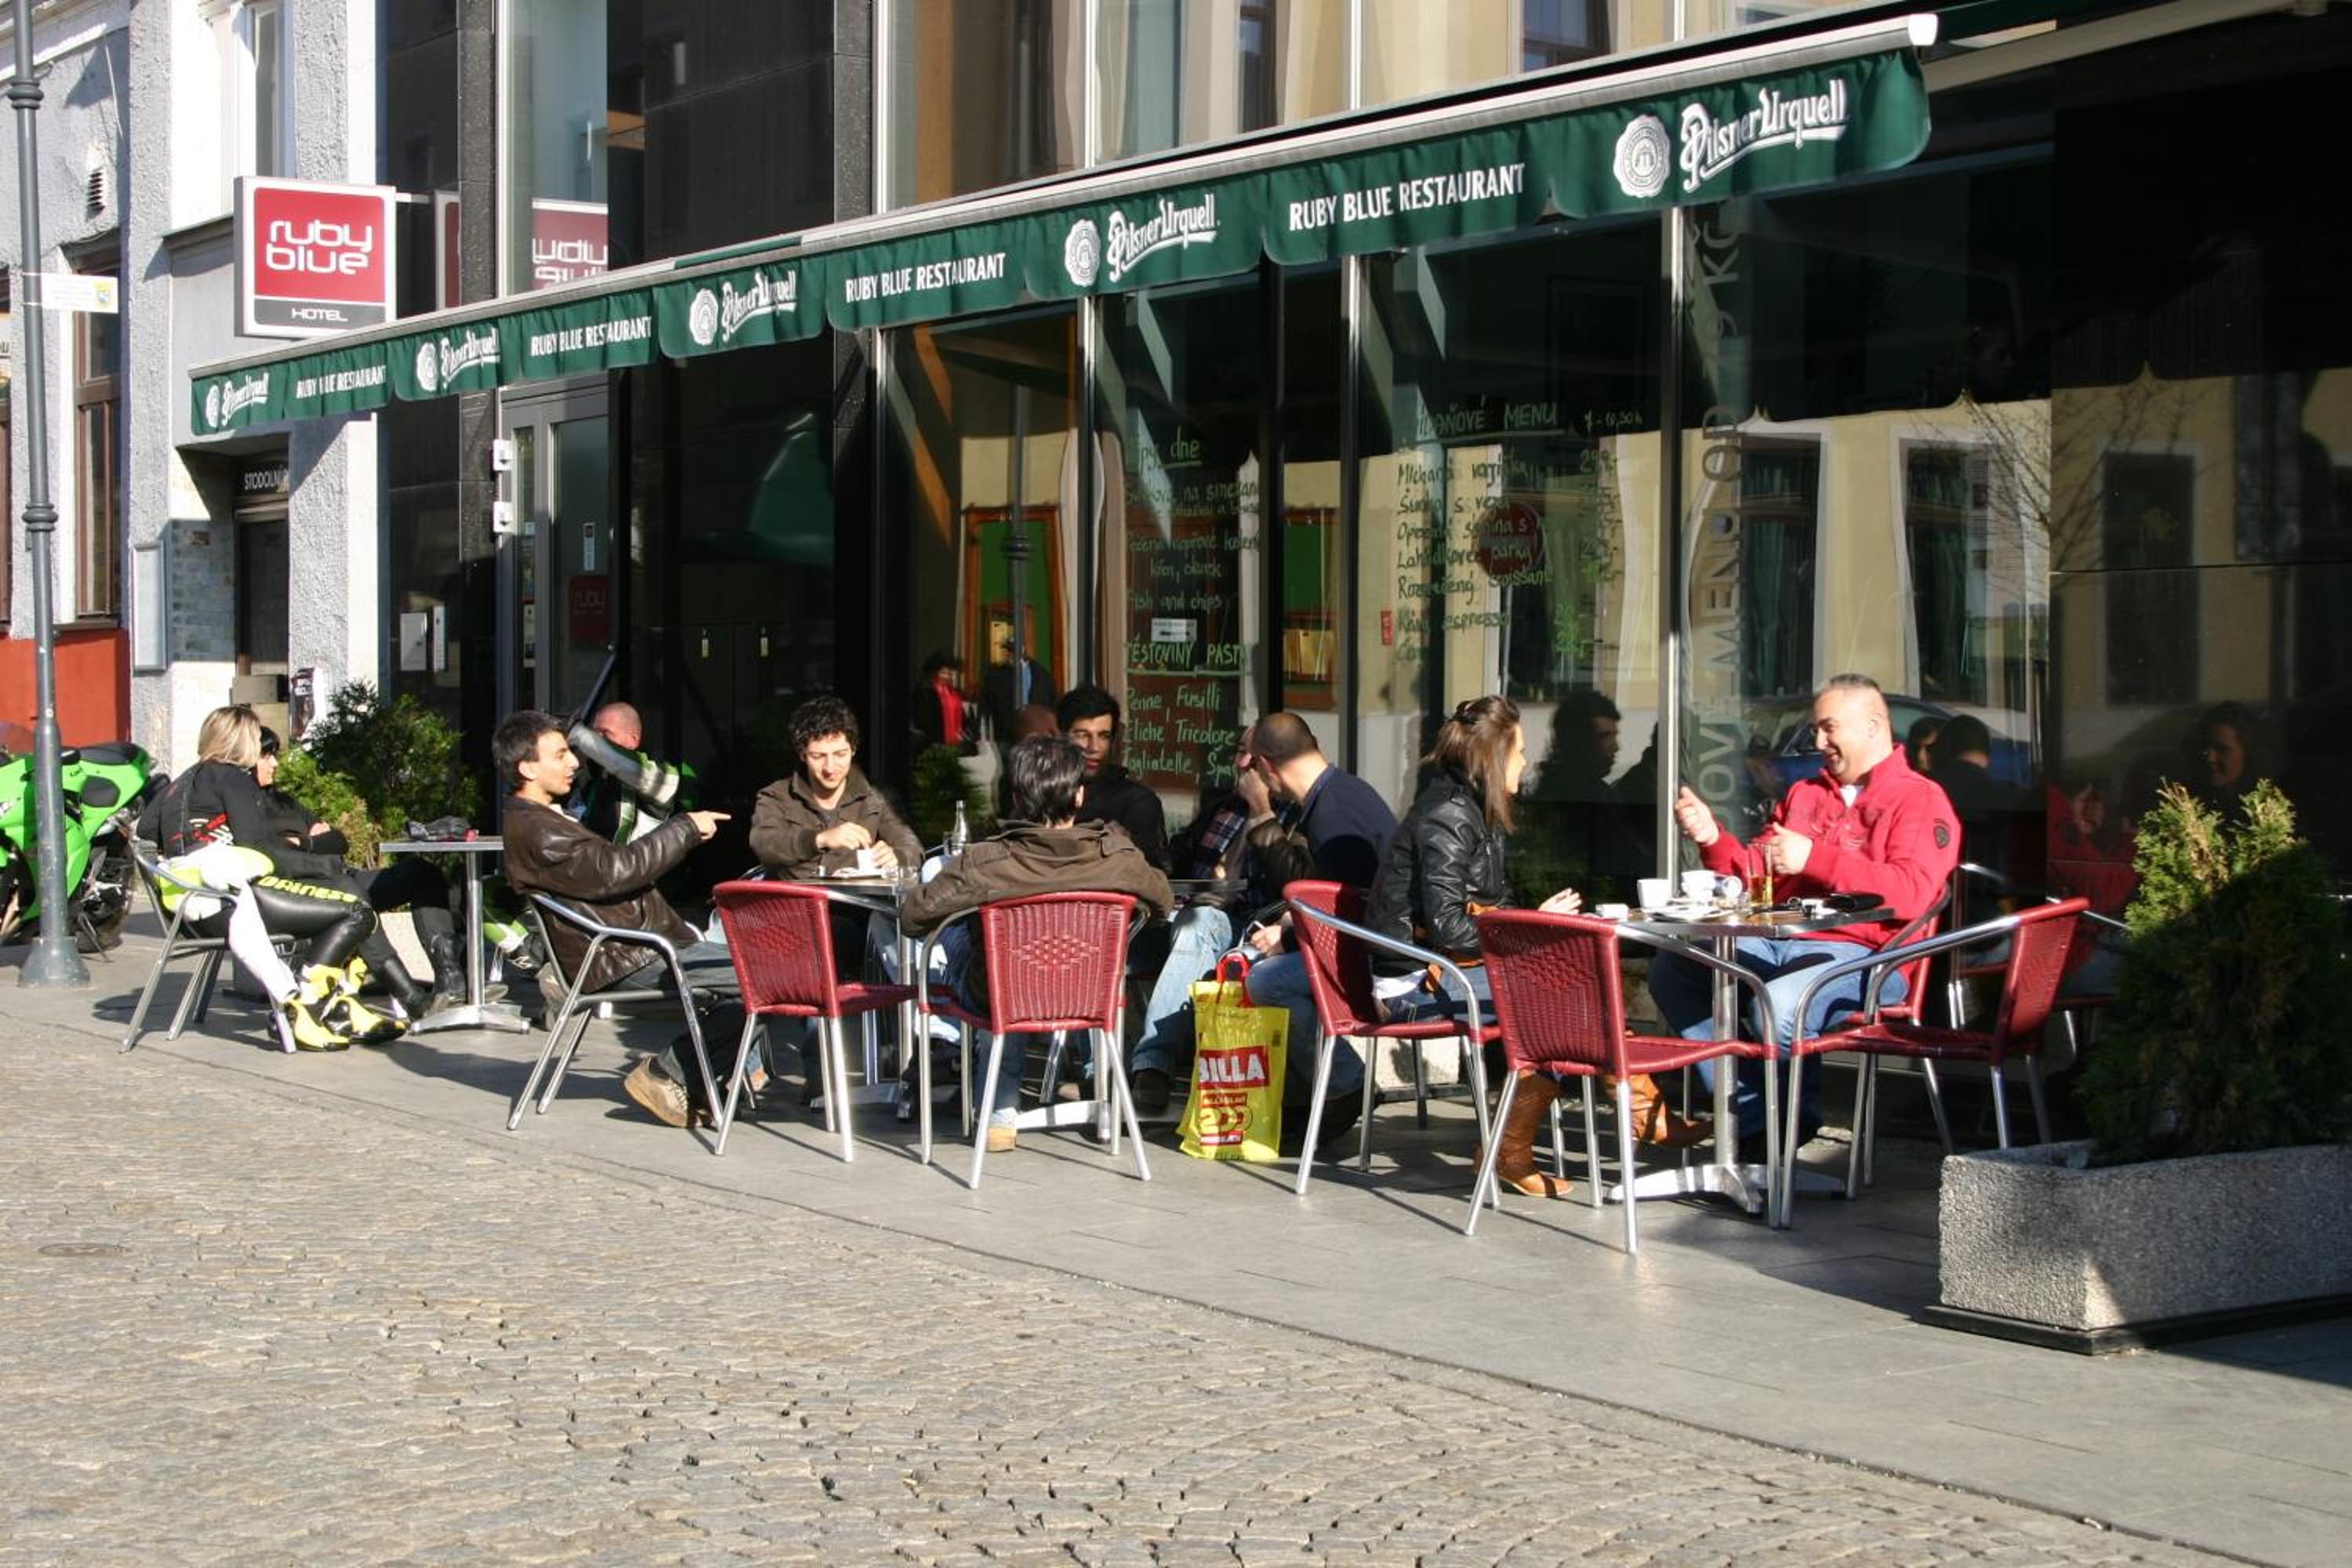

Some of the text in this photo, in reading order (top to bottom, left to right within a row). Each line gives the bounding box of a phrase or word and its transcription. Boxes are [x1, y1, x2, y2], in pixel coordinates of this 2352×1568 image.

[1290, 163, 1526, 231] RUBY BLUE RESTAURANT
[269, 220, 372, 252] ruby
[266, 242, 368, 275] blue
[845, 252, 1007, 303] RUBY BLUE RESTAURANT
[291, 307, 348, 322] HOTEL
[530, 333, 559, 357] RUBY
[1504, 402, 1557, 430] MENU
[1171, 426, 1200, 459] dne
